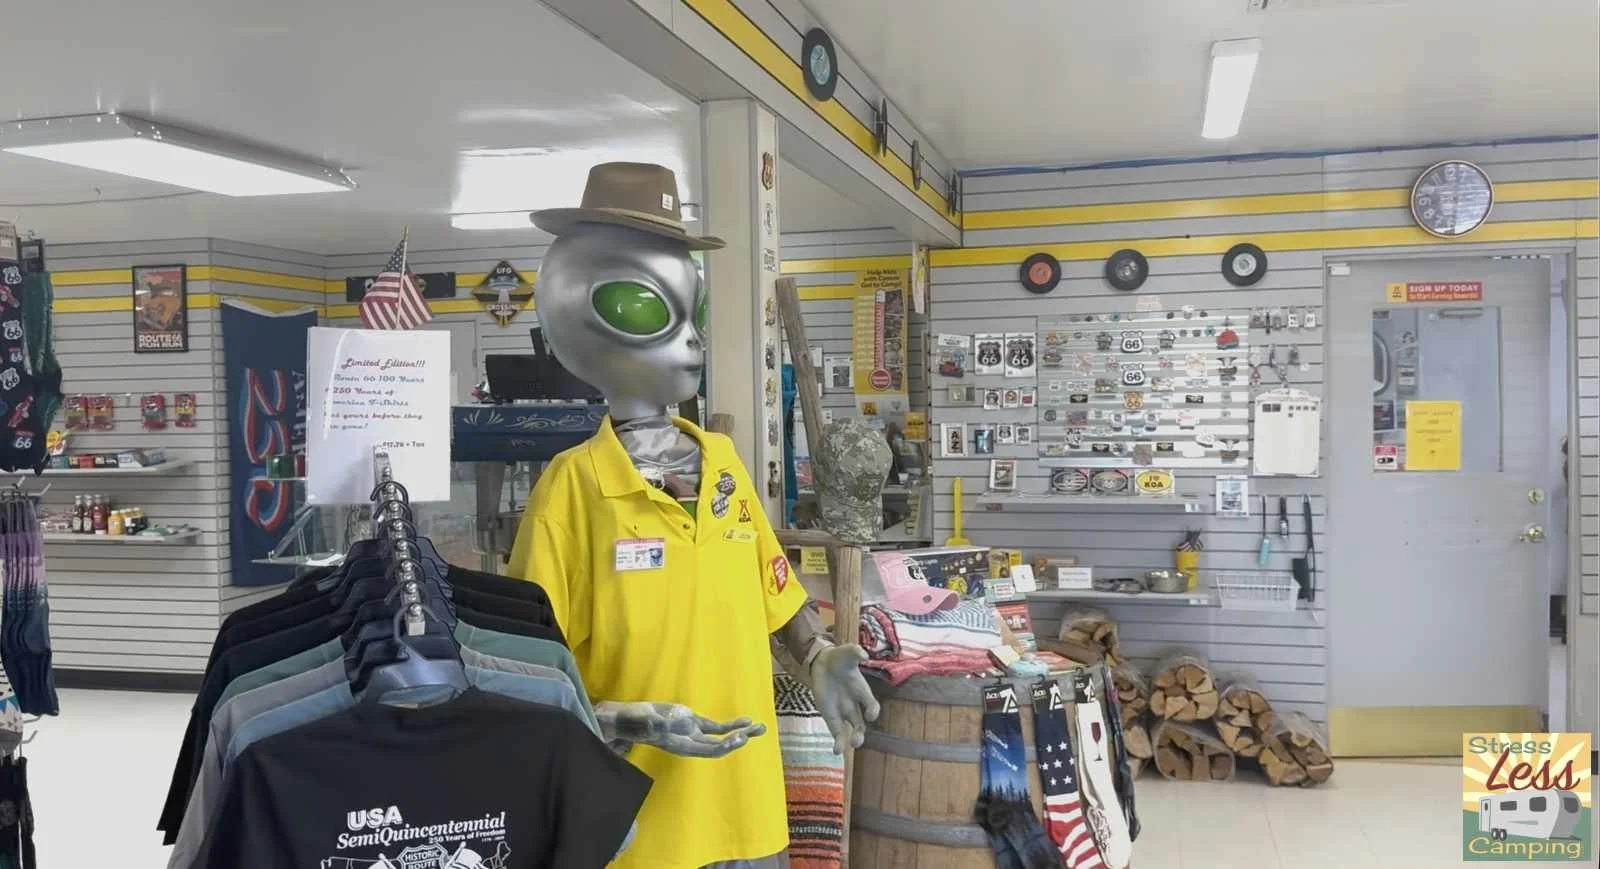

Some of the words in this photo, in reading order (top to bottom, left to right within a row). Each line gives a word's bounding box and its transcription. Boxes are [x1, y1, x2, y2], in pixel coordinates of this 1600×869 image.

[1410, 284, 1432, 292] SIGN
[1434, 284, 1447, 292] UP
[1449, 284, 1479, 292] TODAY
[1124, 339, 1140, 350] 66
[341, 358, 380, 370] Limited
[982, 353, 998, 365] 66
[1012, 353, 1029, 366] 66
[1126, 372, 1141, 382] 66
[15, 436, 32, 449] 66
[346, 805, 403, 831] USA
[336, 811, 506, 849] SemiQuincentennial
[445, 834, 466, 842] Years
[475, 828, 506, 838] Freedom
[404, 850, 440, 861] HISTORIC
